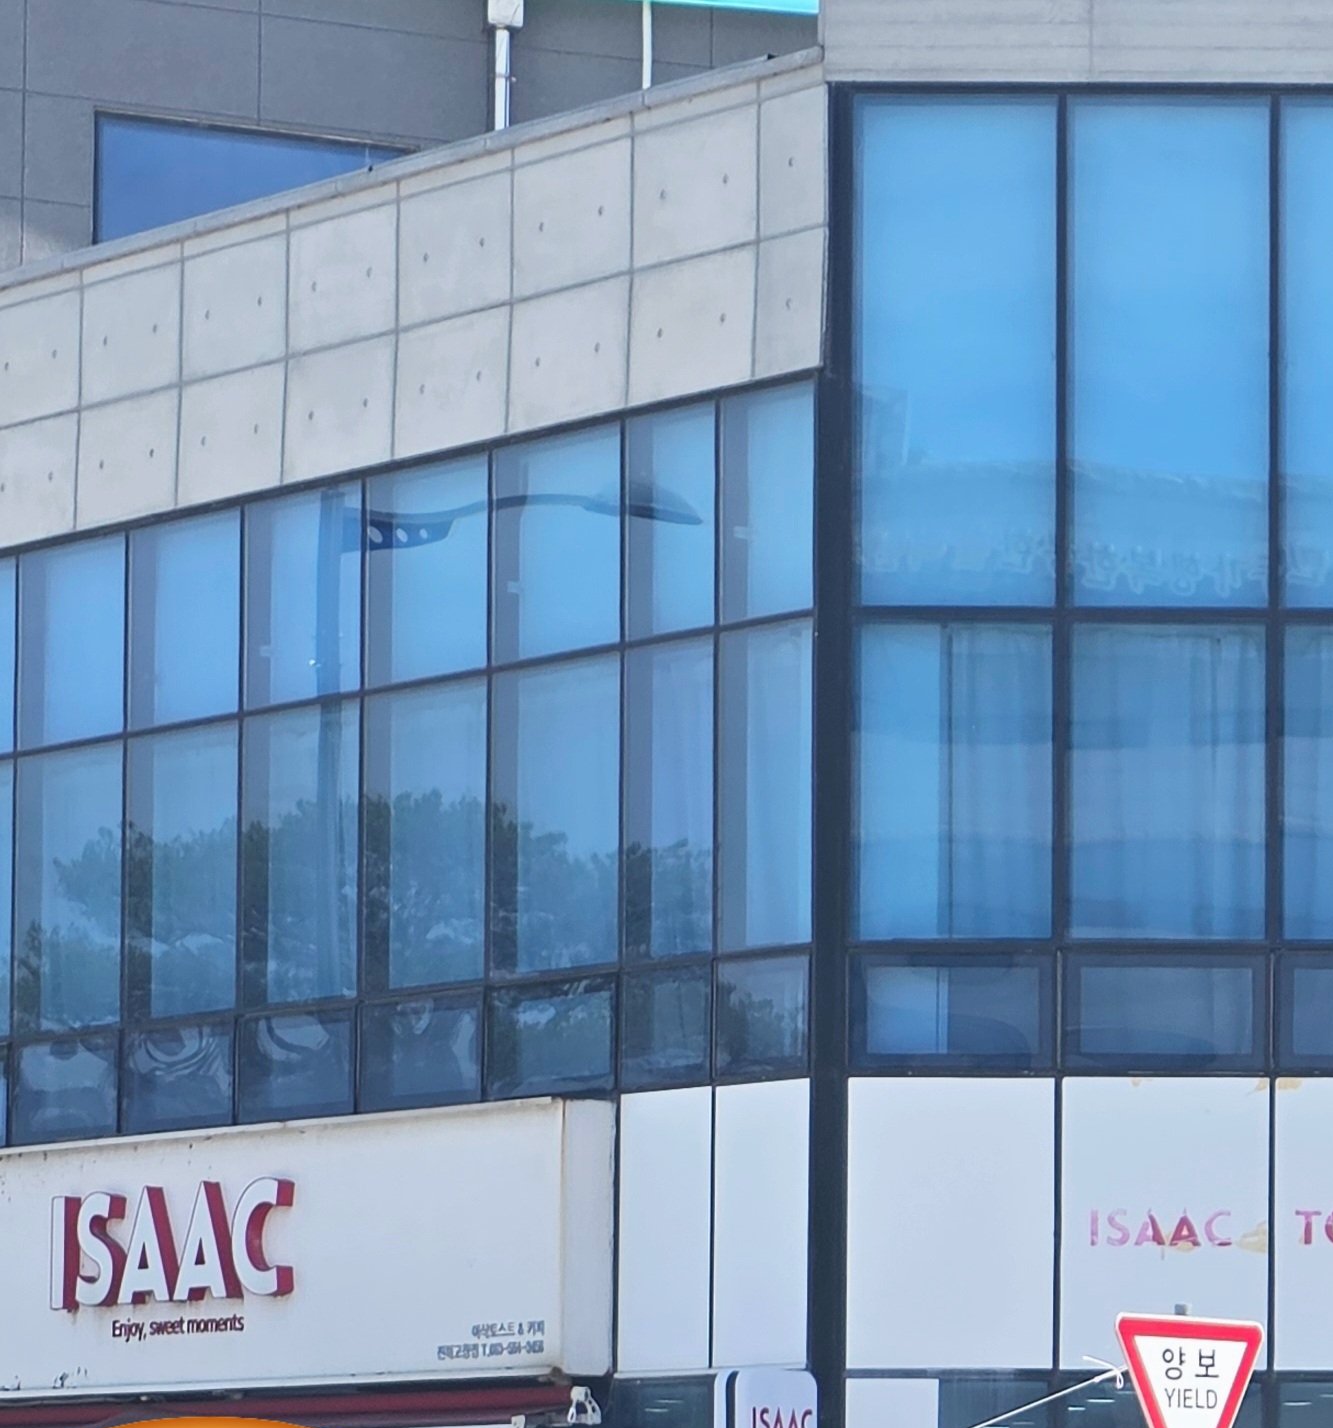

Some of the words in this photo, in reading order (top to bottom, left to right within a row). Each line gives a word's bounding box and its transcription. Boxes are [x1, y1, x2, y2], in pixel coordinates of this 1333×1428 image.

[51, 1176, 295, 1312] ISAAC
[1090, 1210, 1232, 1247] ISAAC
[112, 1320, 147, 1342] Enjoy,
[149, 1317, 185, 1336] sweet
[187, 1314, 244, 1335] moments
[1162, 1348, 1219, 1379] 양보
[1164, 1387, 1217, 1409] YIELD
